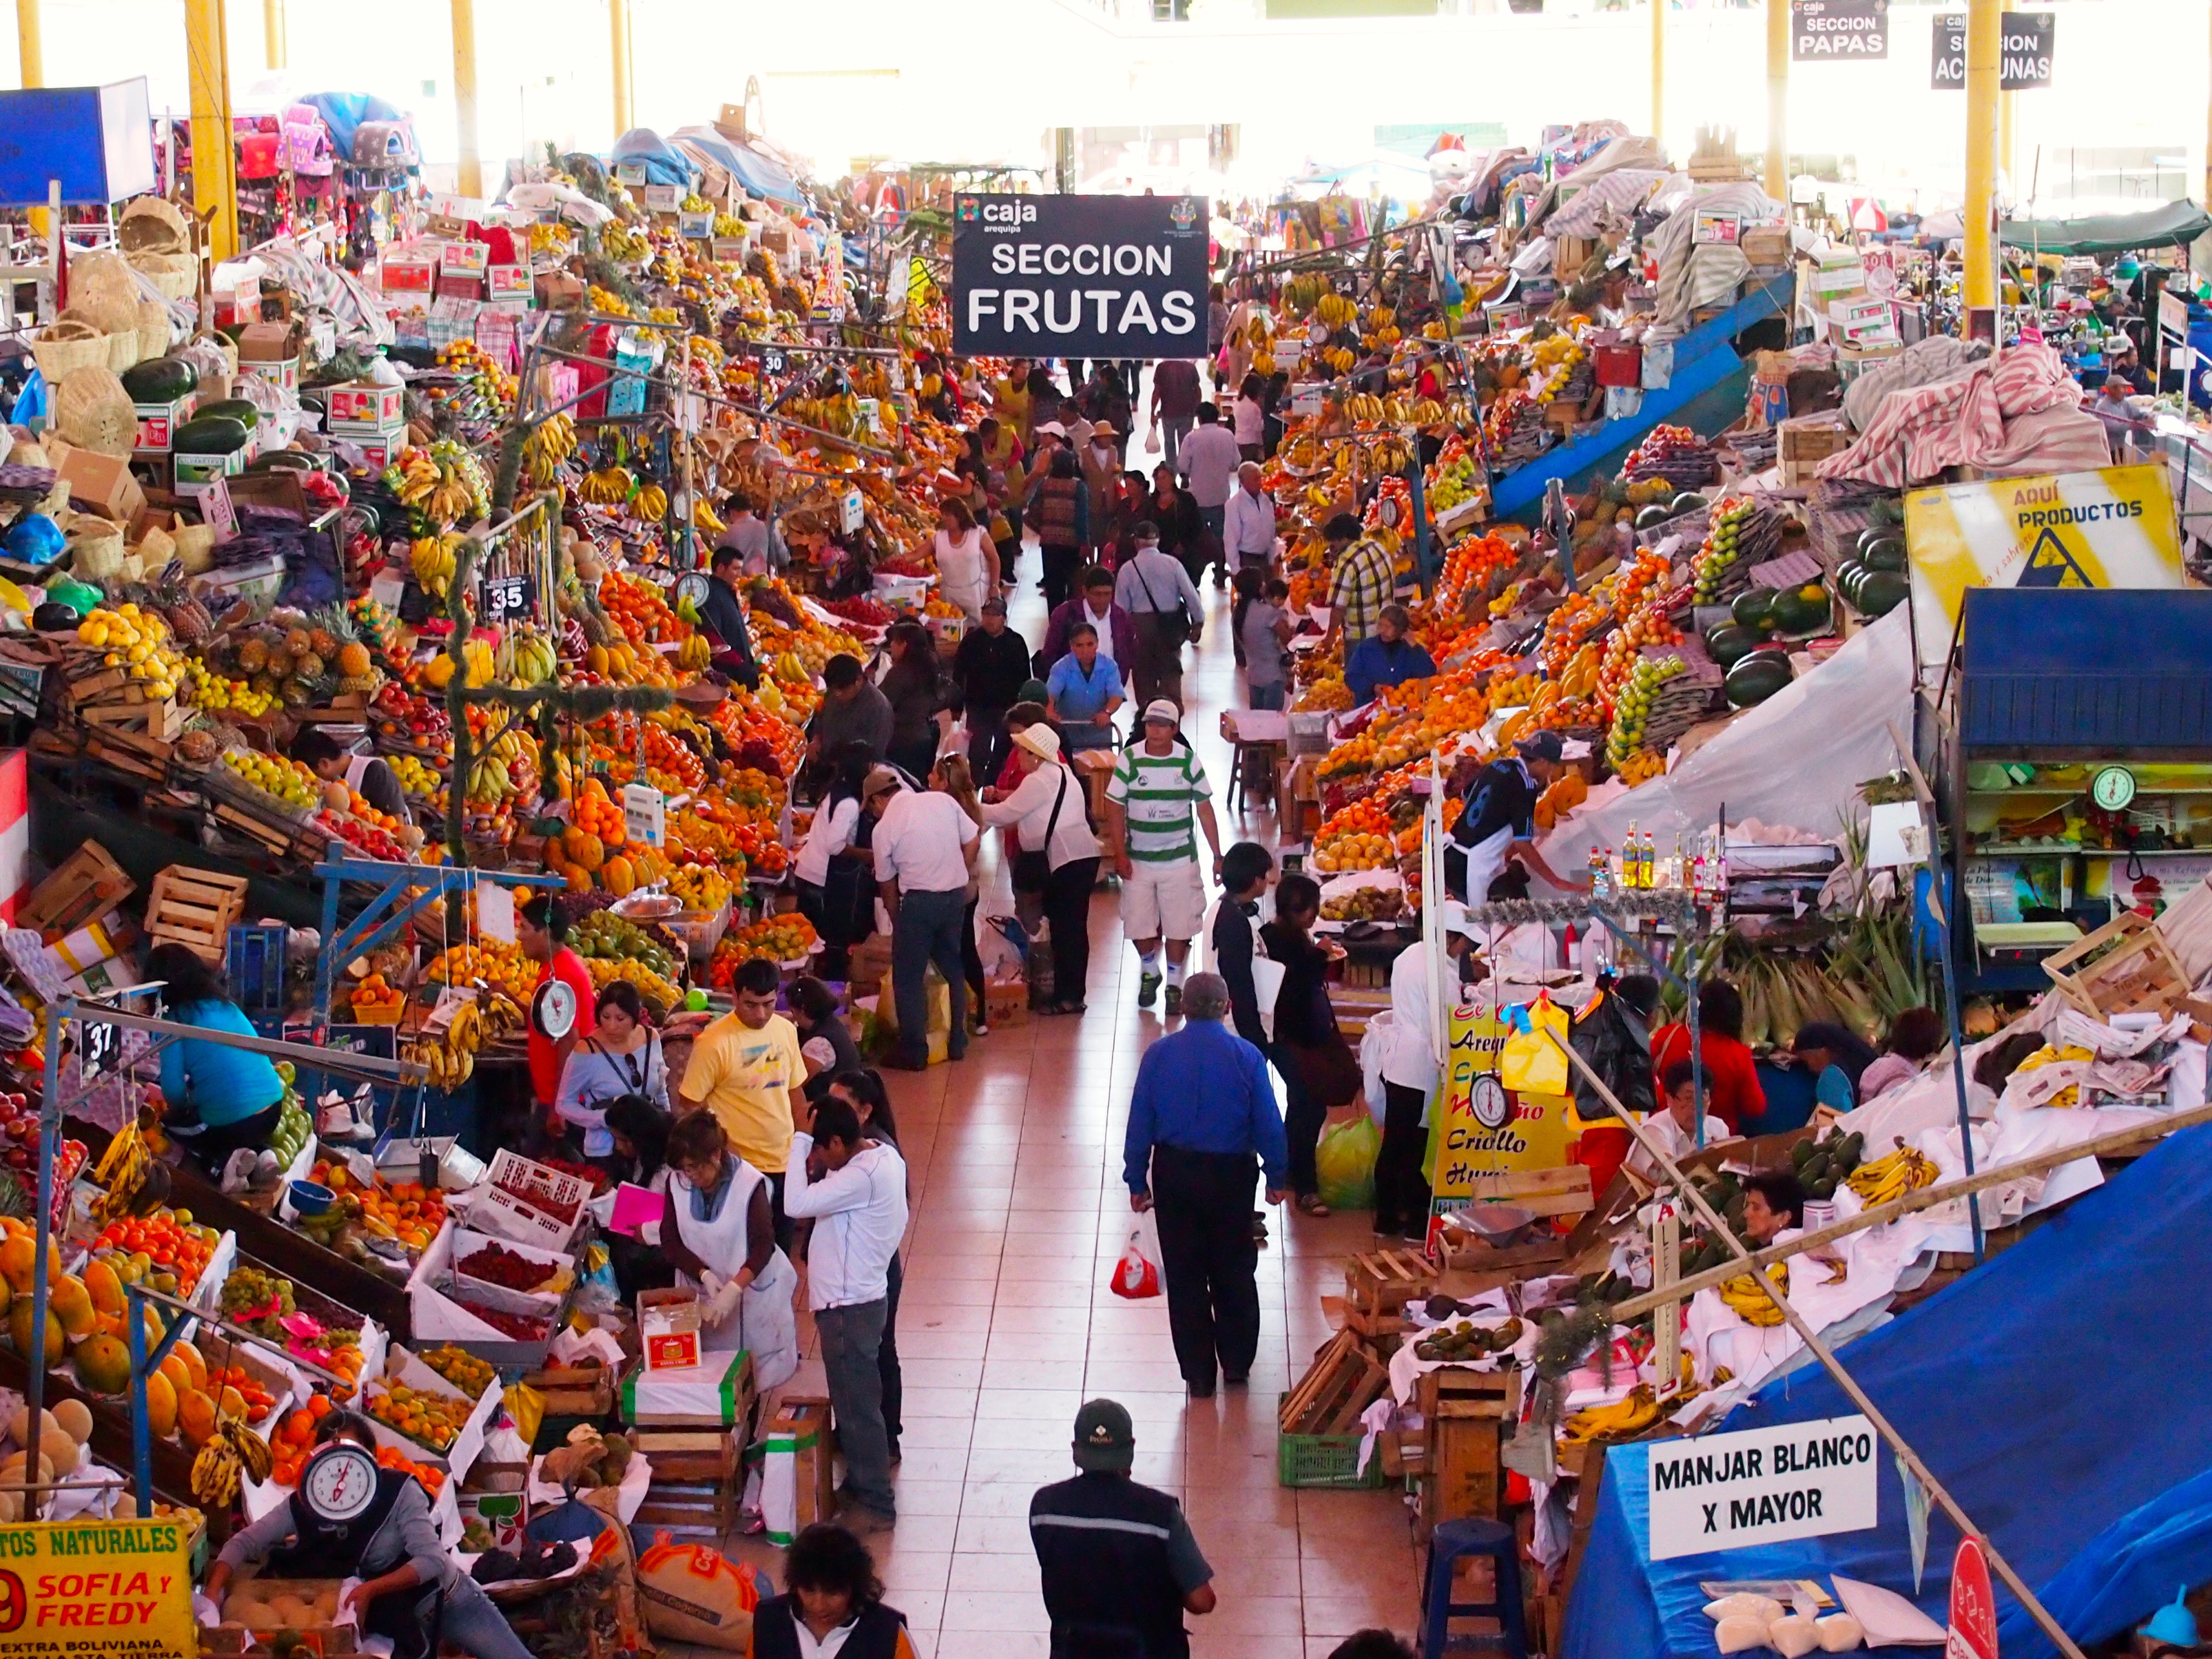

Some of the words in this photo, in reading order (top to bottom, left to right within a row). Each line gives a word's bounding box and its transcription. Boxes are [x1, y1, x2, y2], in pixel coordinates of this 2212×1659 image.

[1807, 17, 1876, 31] SECCION
[1946, 15, 1966, 28] caj
[1799, 34, 1883, 54] PAPAS
[983, 199, 1037, 226] caja
[984, 225, 1021, 233] arequipa
[992, 243, 1172, 276] SECCION
[1335, 281, 1352, 294] 54
[829, 307, 843, 323] 29
[968, 289, 1196, 335] FRUTAS
[766, 357, 782, 371] 30
[2014, 479, 2059, 506] AQUÍ
[2018, 500, 2143, 528] PRODUCTOS
[2001, 531, 2035, 568] sabroso
[492, 586, 523, 610] 35
[1454, 1002, 1486, 1020] El
[90, 1023, 112, 1060] 37
[1447, 1128, 1527, 1153] Criollo
[1655, 1448, 1763, 1492] MANJAR
[1774, 1433, 1871, 1475] BLANCO
[1702, 1502, 1718, 1534] X
[1730, 1488, 1823, 1530] MAYOR
[49, 1527, 178, 1556] NATURALES
[35, 1572, 150, 1599] SOFIA
[160, 1575, 172, 1594] Y
[36, 1601, 159, 1627] FREDY
[1, 1642, 60, 1654] EXTRA
[65, 1639, 163, 1652] BOLIVIANA
